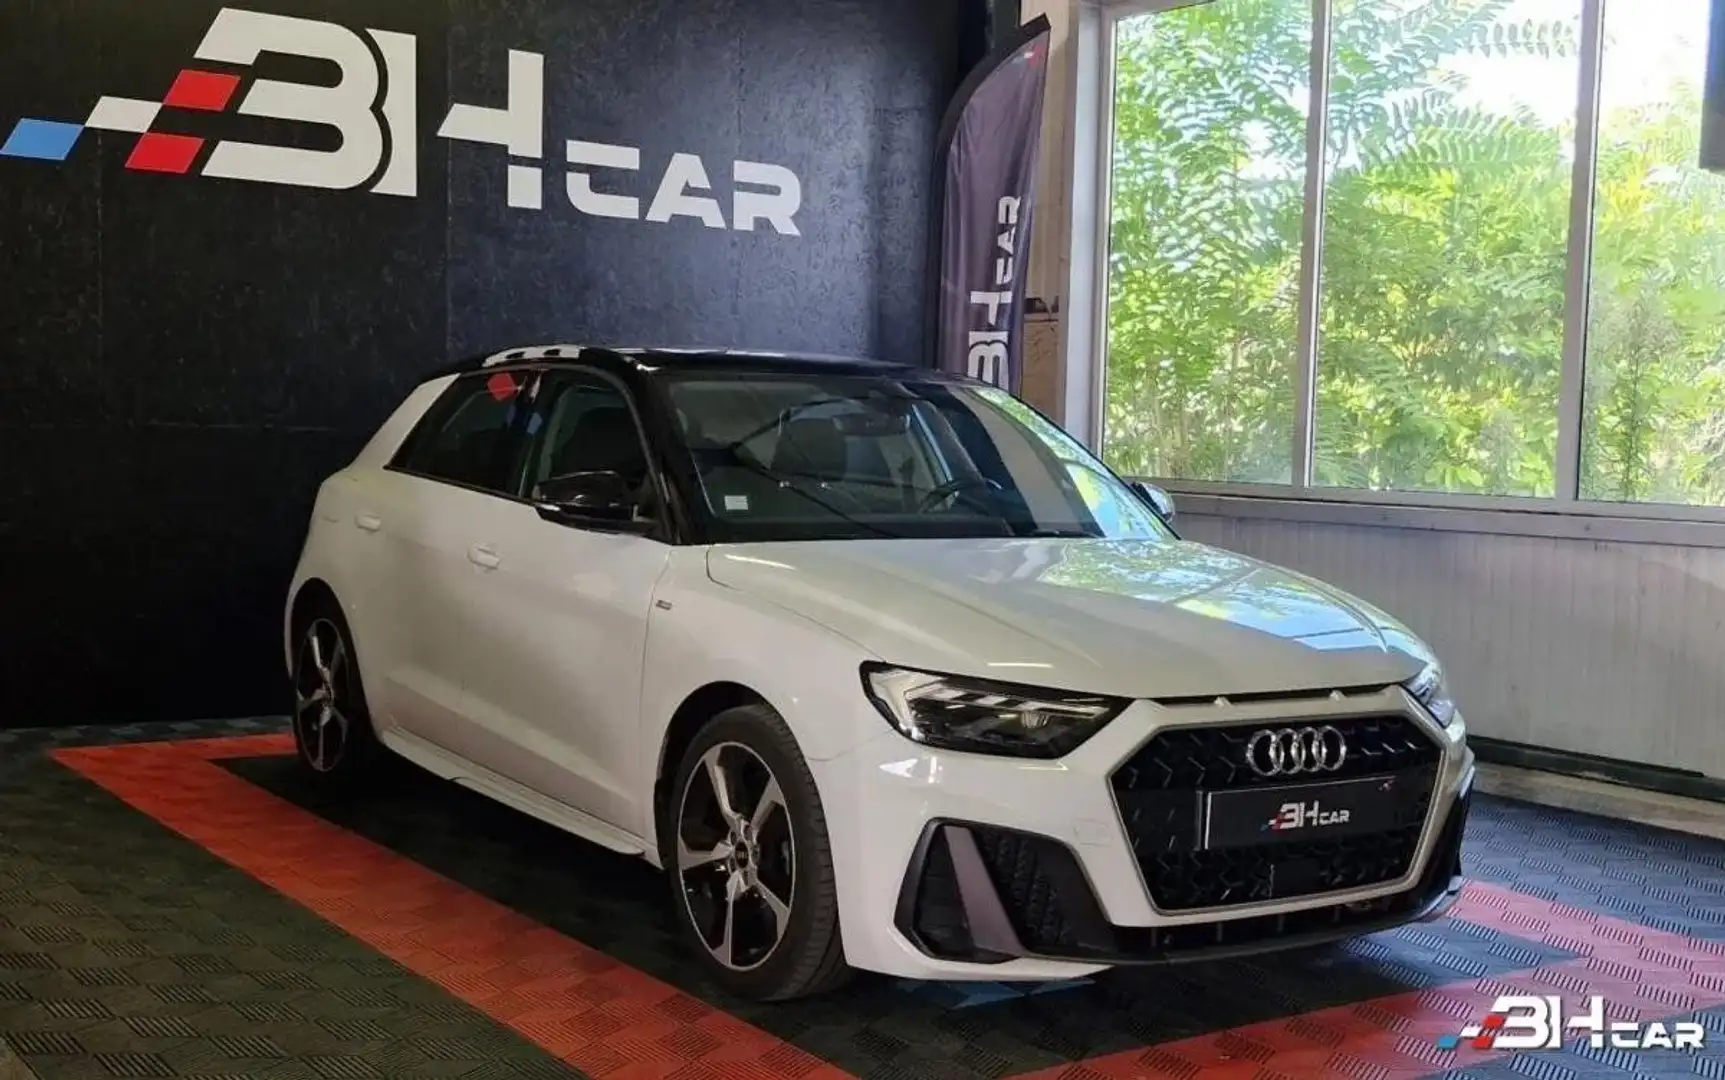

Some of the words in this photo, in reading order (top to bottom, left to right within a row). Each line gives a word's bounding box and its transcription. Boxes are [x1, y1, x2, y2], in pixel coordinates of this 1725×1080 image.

[566, 139, 801, 236] CAR
[997, 196, 1021, 285] CAR
[1319, 809, 1350, 825] CAR
